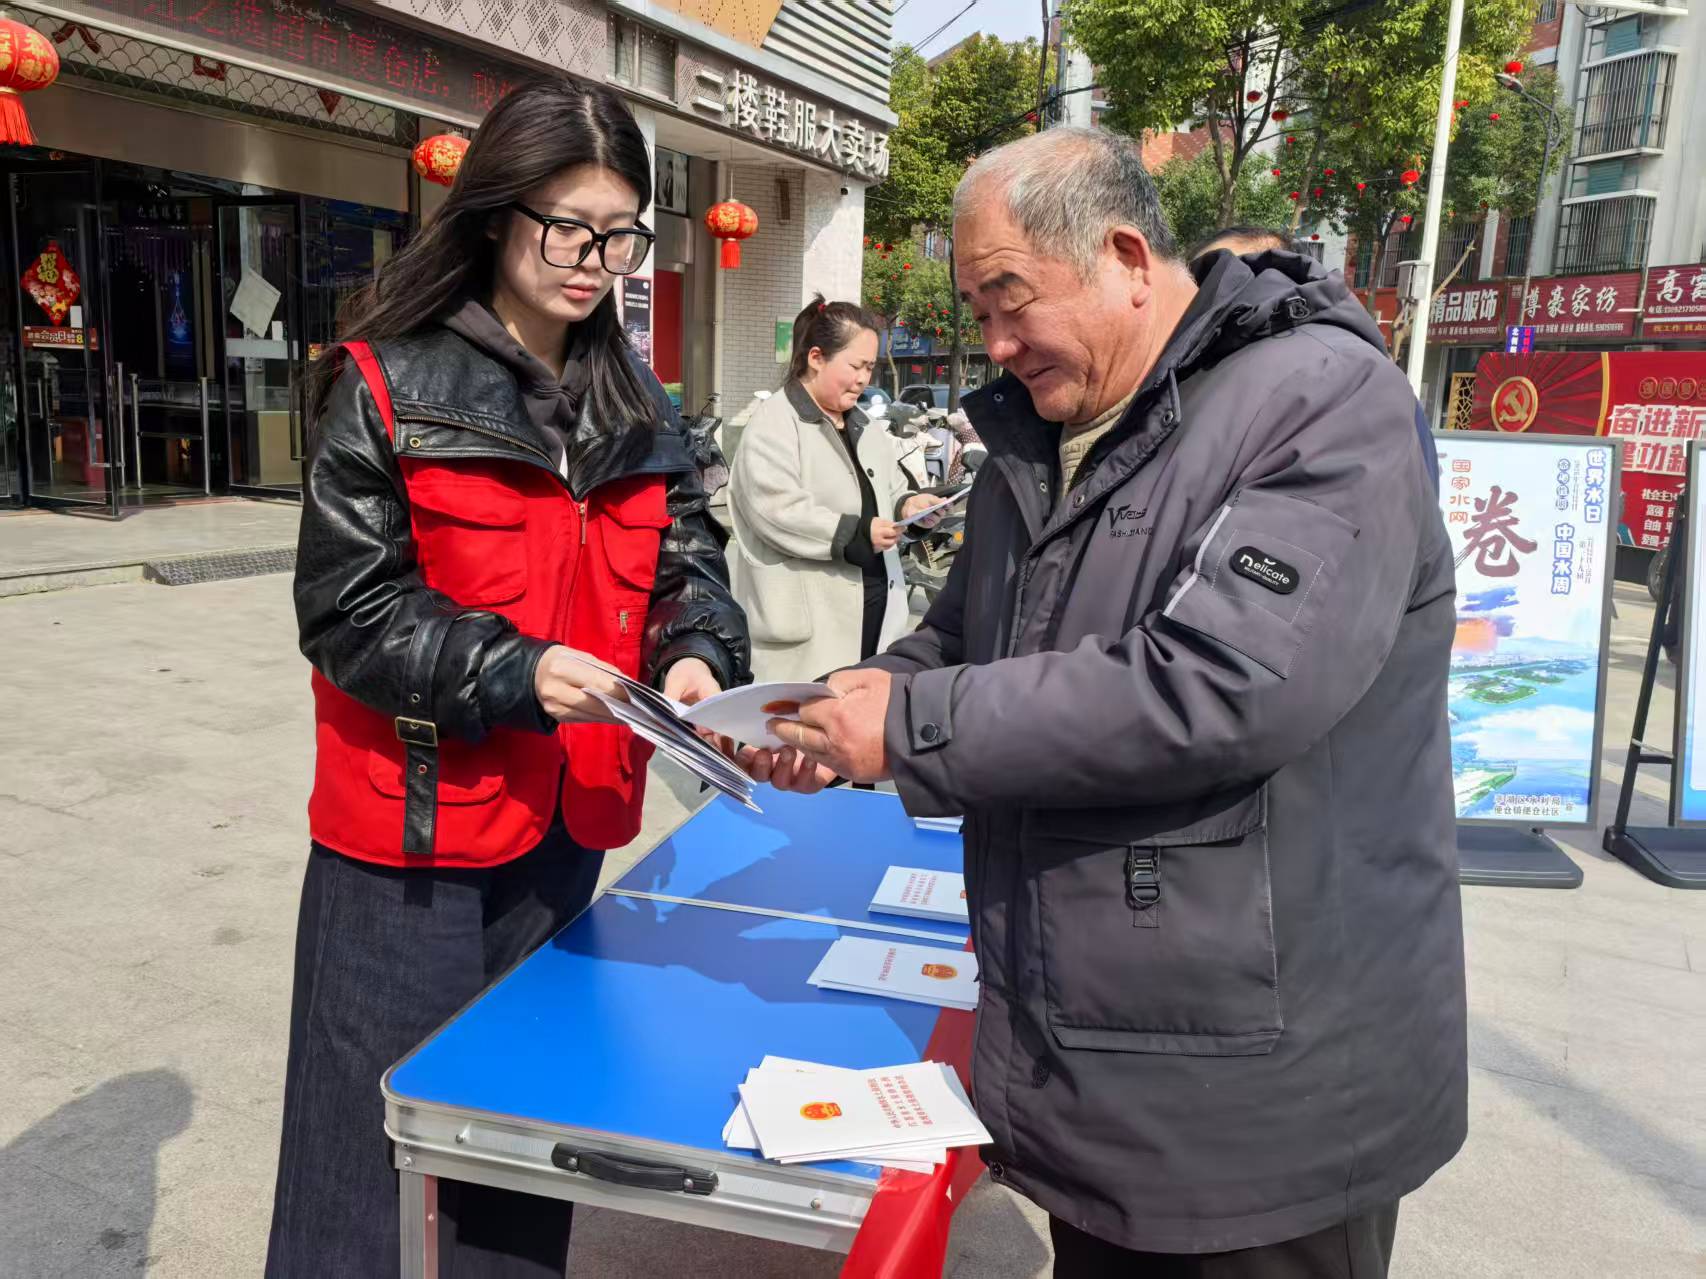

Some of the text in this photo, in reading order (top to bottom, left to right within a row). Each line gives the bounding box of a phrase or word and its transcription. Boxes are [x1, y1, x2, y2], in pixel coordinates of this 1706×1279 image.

[693, 67, 890, 177] 二楼鞋服大卖场
[1431, 289, 1499, 324] 精品服饰
[1449, 459, 1472, 524] 国家水网
[1584, 448, 1607, 524] 世界水日
[1455, 485, 1538, 577] 卷
[1551, 522, 1575, 595] 中国水周
[1643, 518, 1661, 532] 自由
